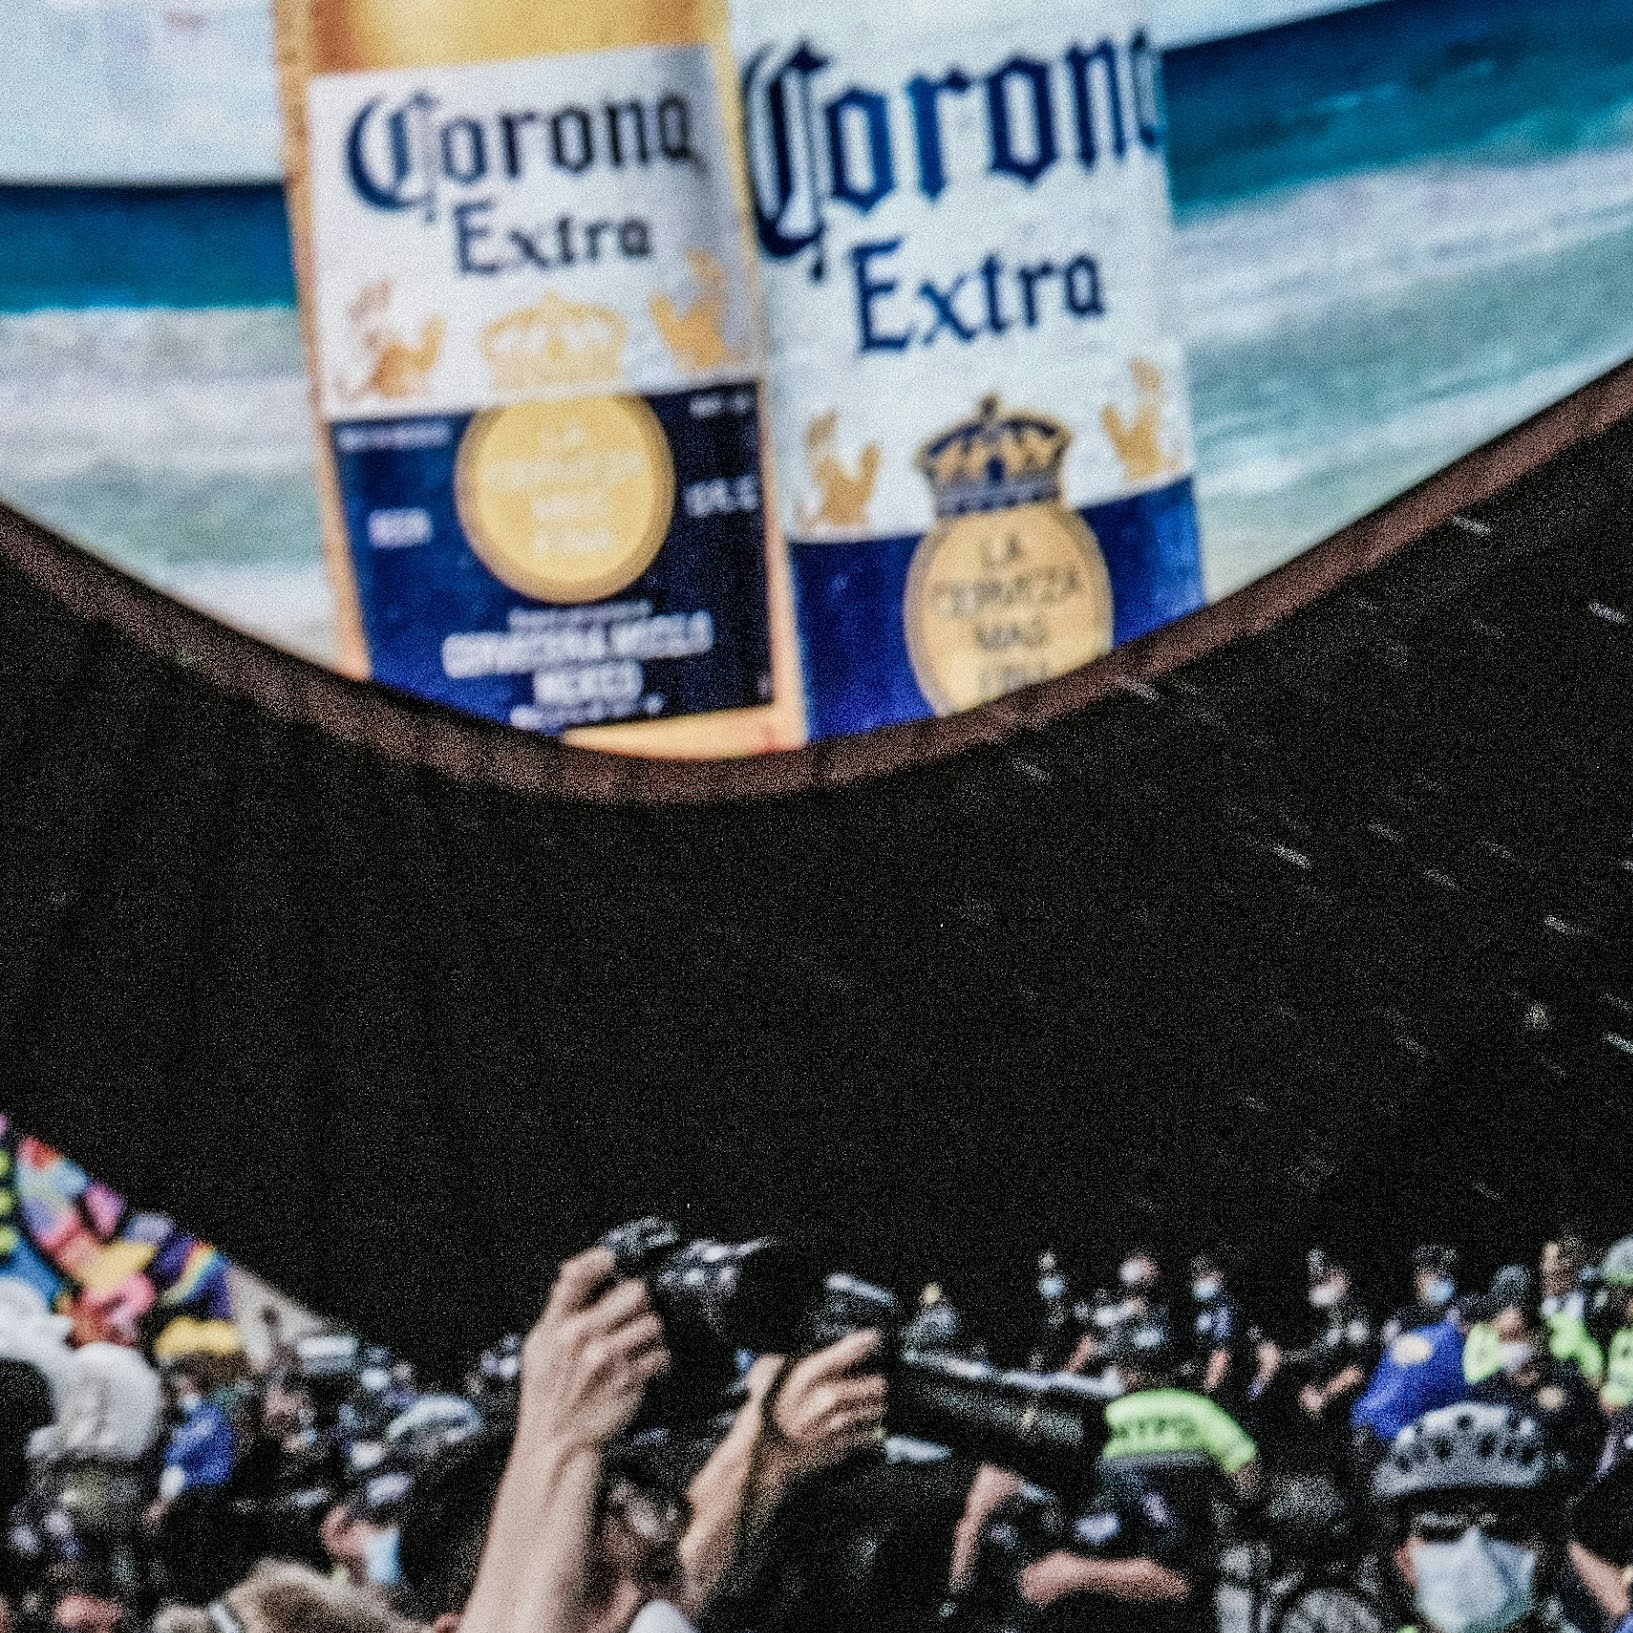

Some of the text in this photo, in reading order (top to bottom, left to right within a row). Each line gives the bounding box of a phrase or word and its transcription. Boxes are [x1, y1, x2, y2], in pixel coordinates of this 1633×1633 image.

[345, 88, 704, 223] Corona
[453, 196, 654, 277] Extra
[849, 236, 1107, 355] Extra
